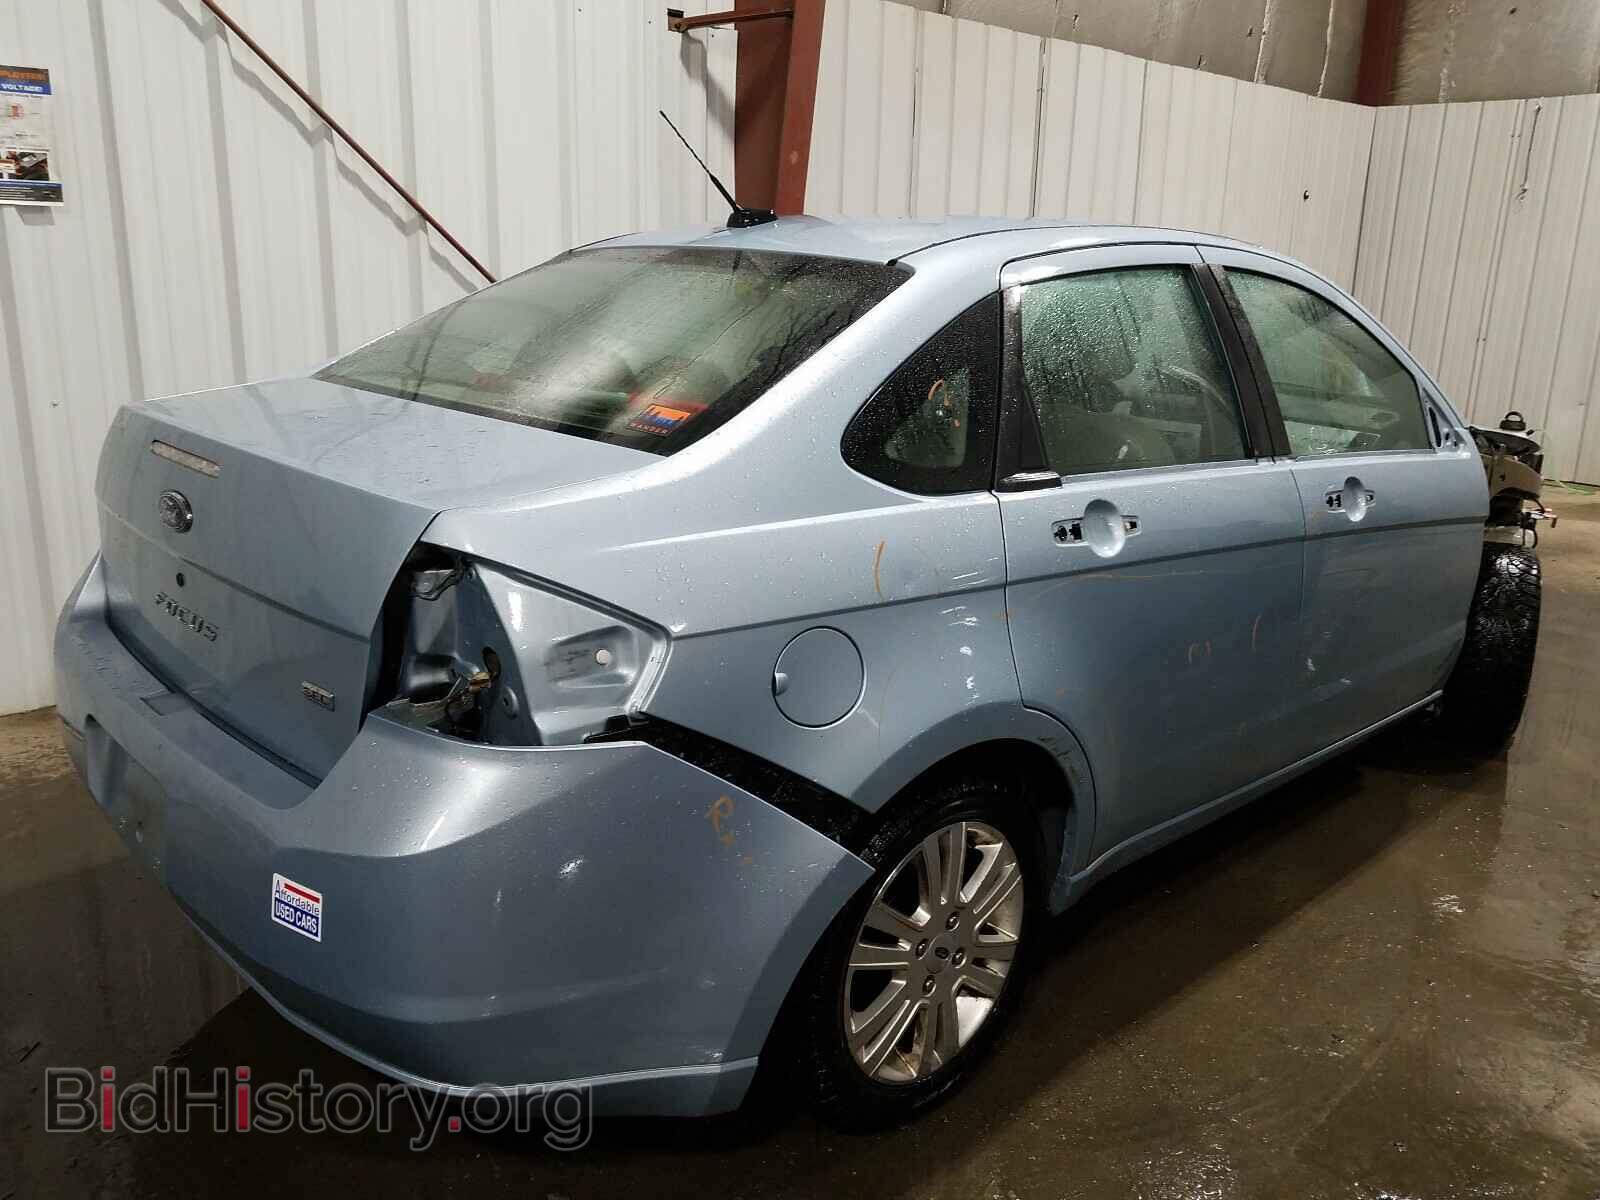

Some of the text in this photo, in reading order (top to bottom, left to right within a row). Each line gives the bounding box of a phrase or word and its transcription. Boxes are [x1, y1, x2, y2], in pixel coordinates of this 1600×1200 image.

[275, 879, 320, 916] Affordable
[275, 900, 318, 934] USED CARS
